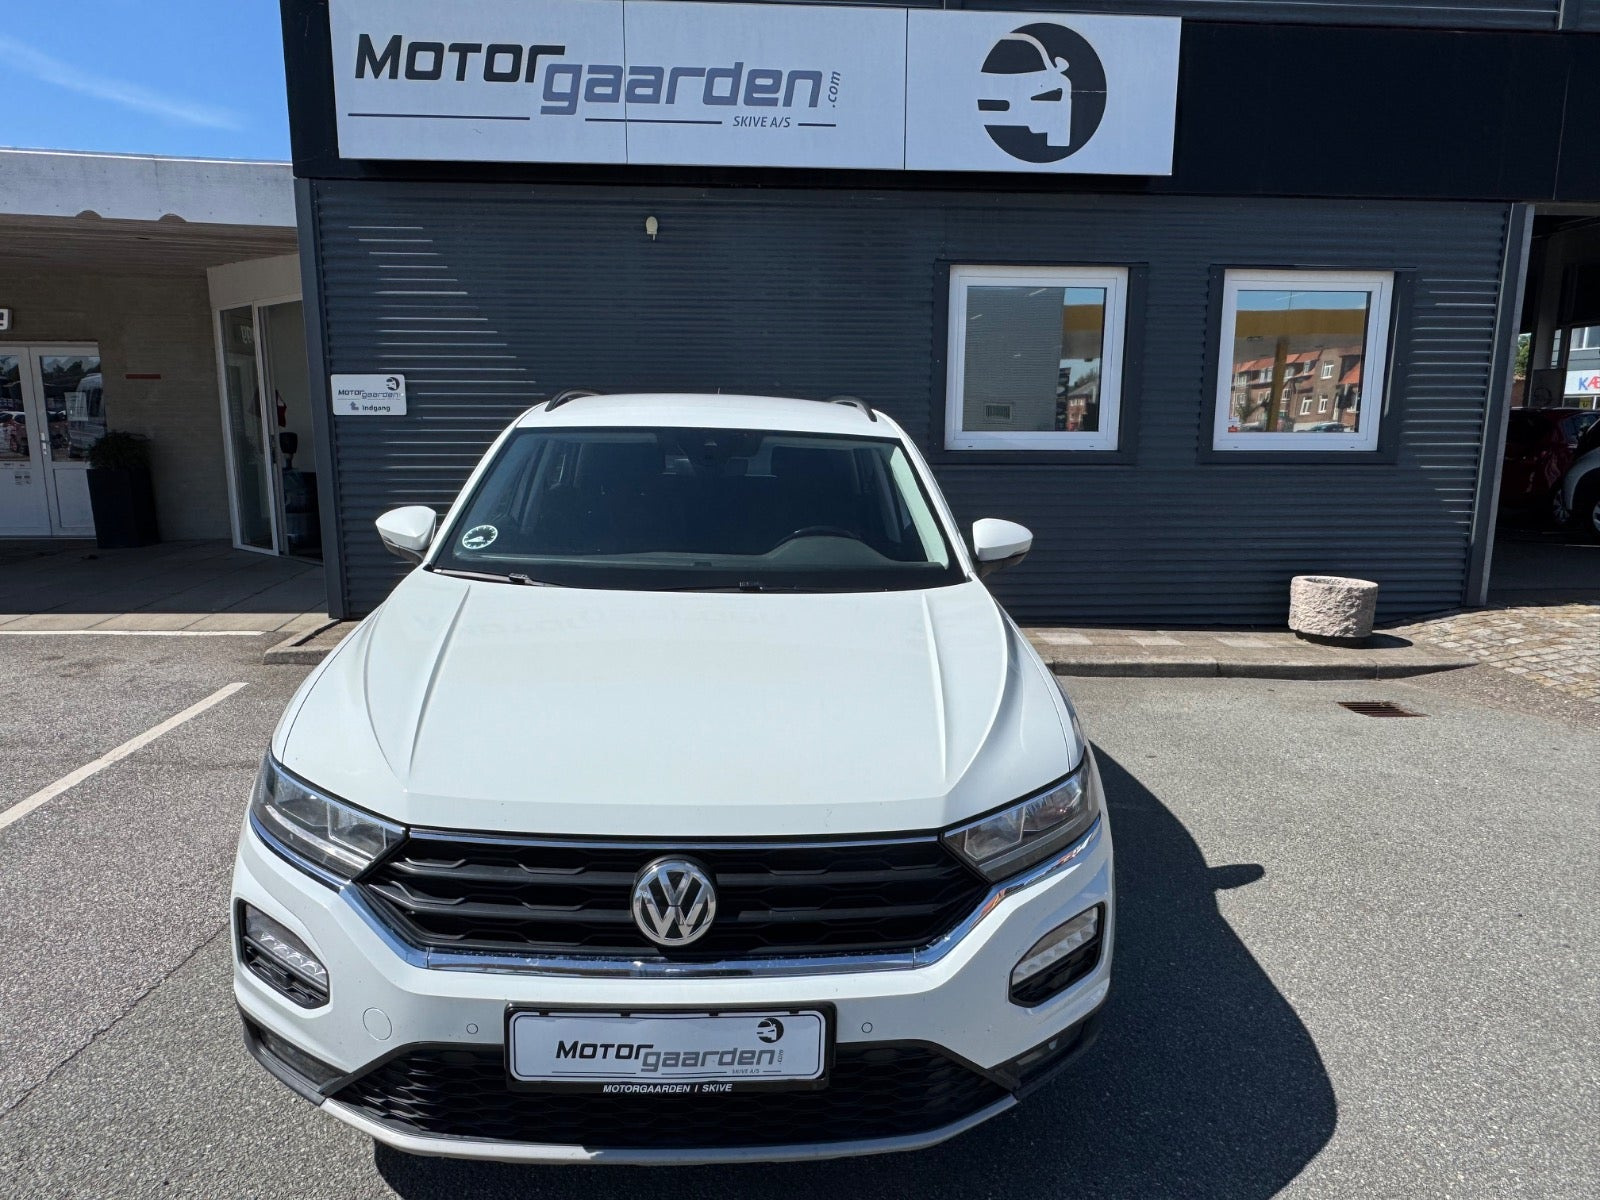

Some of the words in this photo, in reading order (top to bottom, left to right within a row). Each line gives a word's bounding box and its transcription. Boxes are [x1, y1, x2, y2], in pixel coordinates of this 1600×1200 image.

[827, 70, 841, 109] .com
[732, 115, 768, 128] SKIVE
[769, 116, 792, 128] A/S
[602, 1084, 691, 1093] MOTORGAARDEN
[701, 1083, 733, 1092] SKIVE
